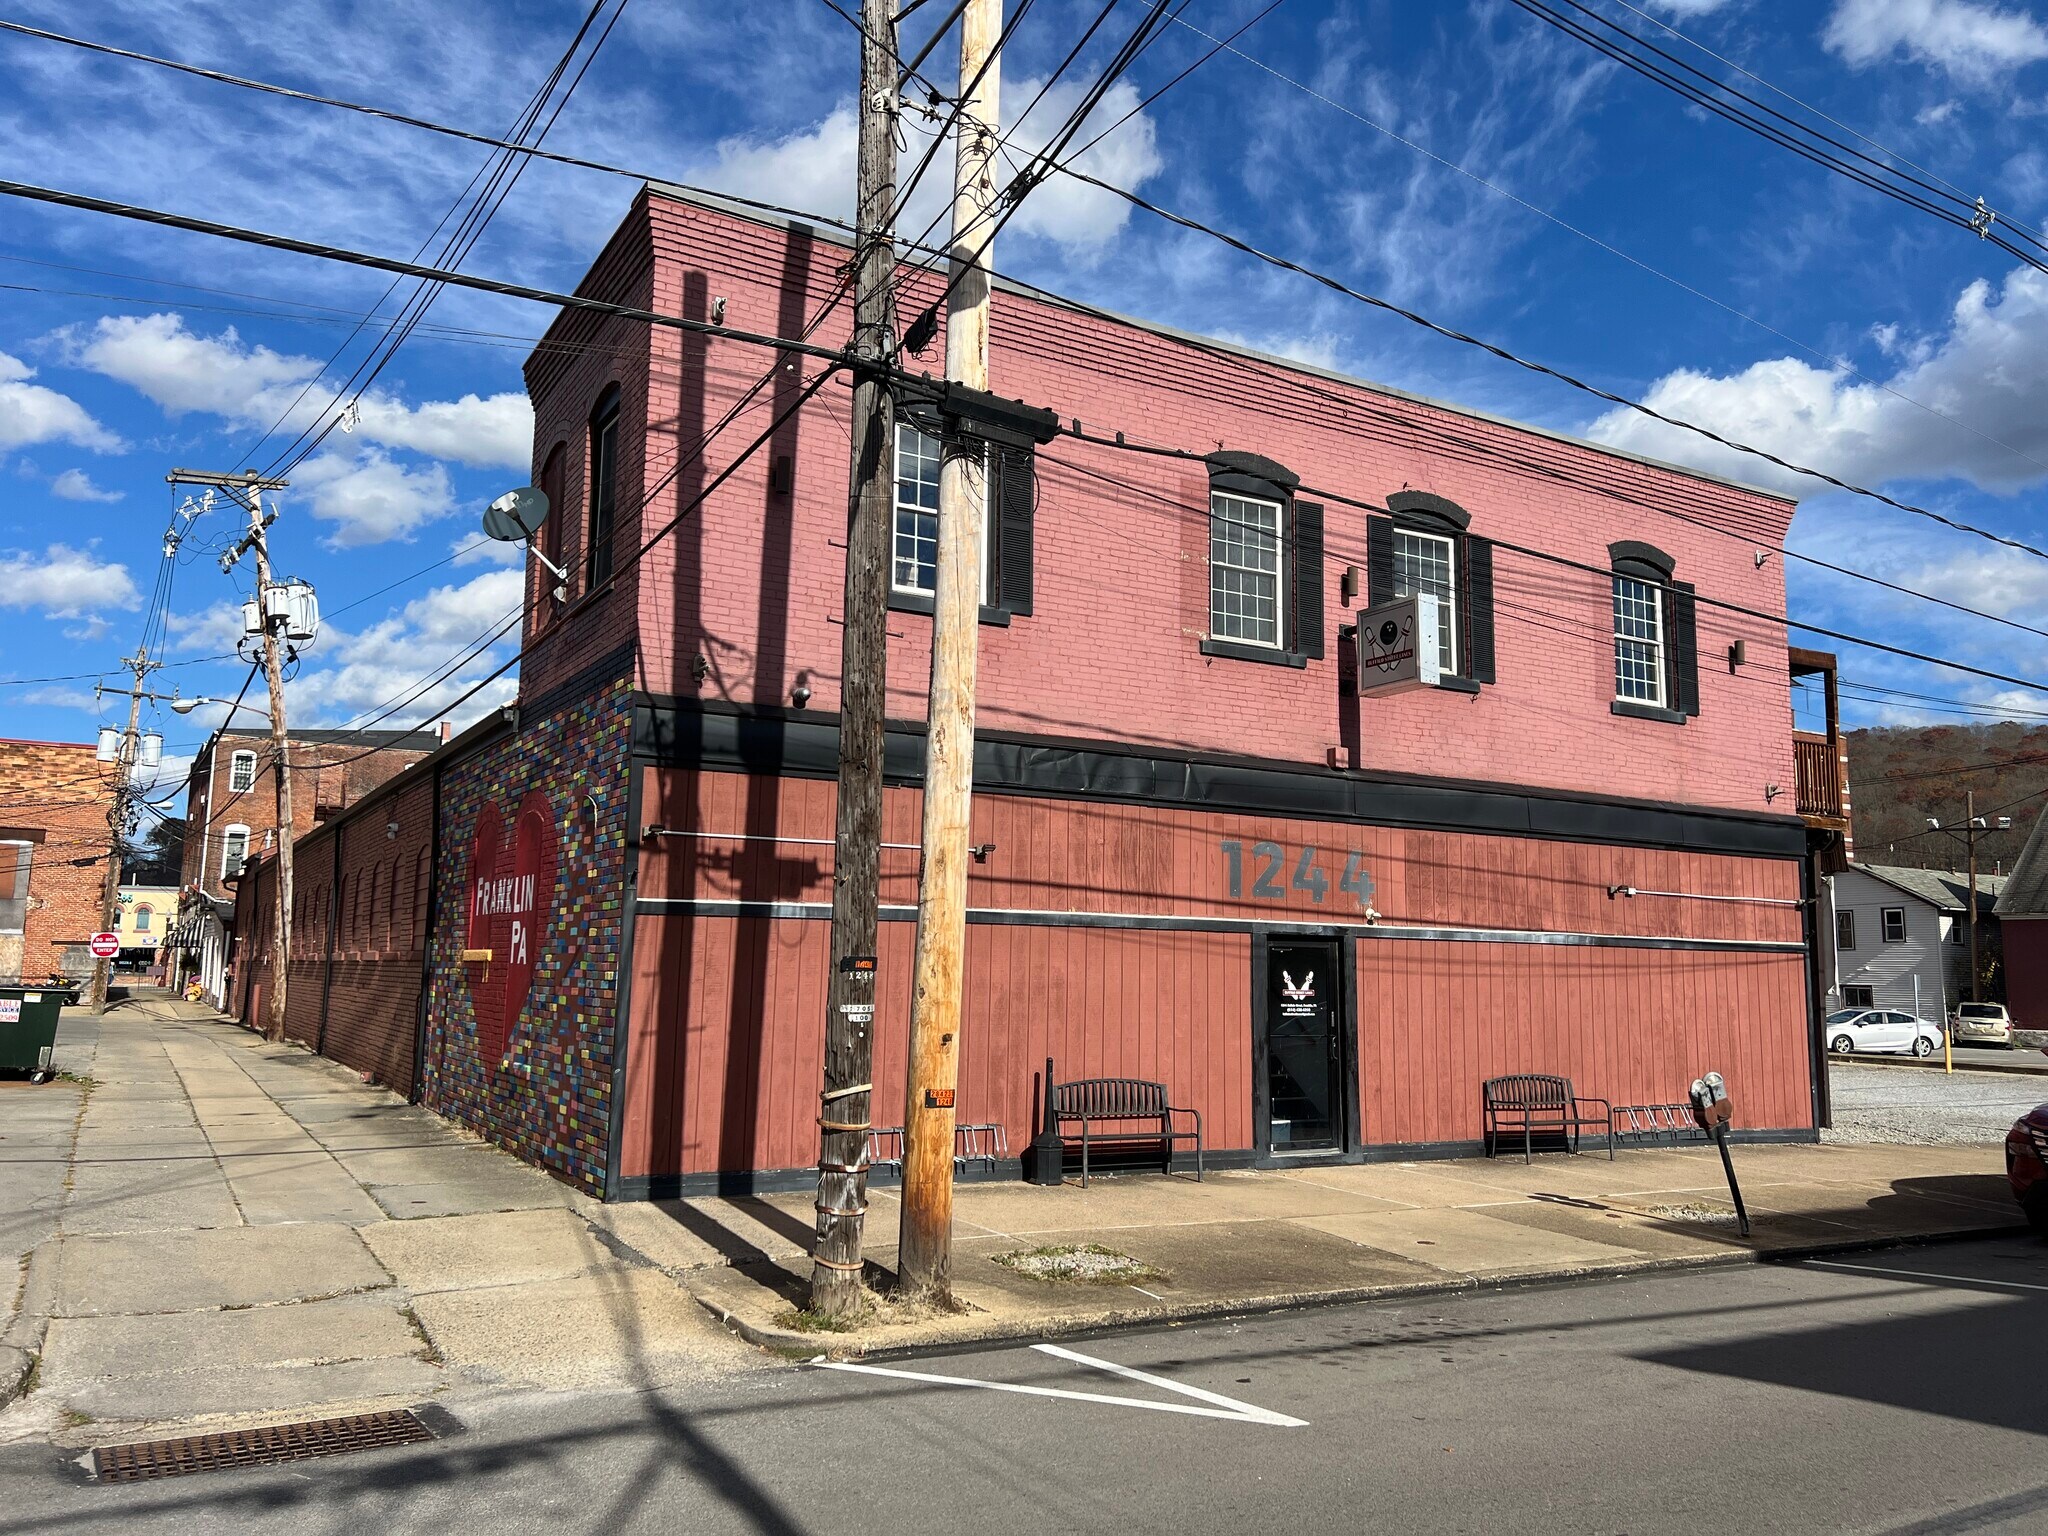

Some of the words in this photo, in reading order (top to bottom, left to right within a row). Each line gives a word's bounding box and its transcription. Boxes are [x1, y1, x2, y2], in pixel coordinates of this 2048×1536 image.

[476, 873, 535, 916] FRANKLIN
[1220, 840, 1376, 904] 1244
[510, 920, 527, 965] PA
